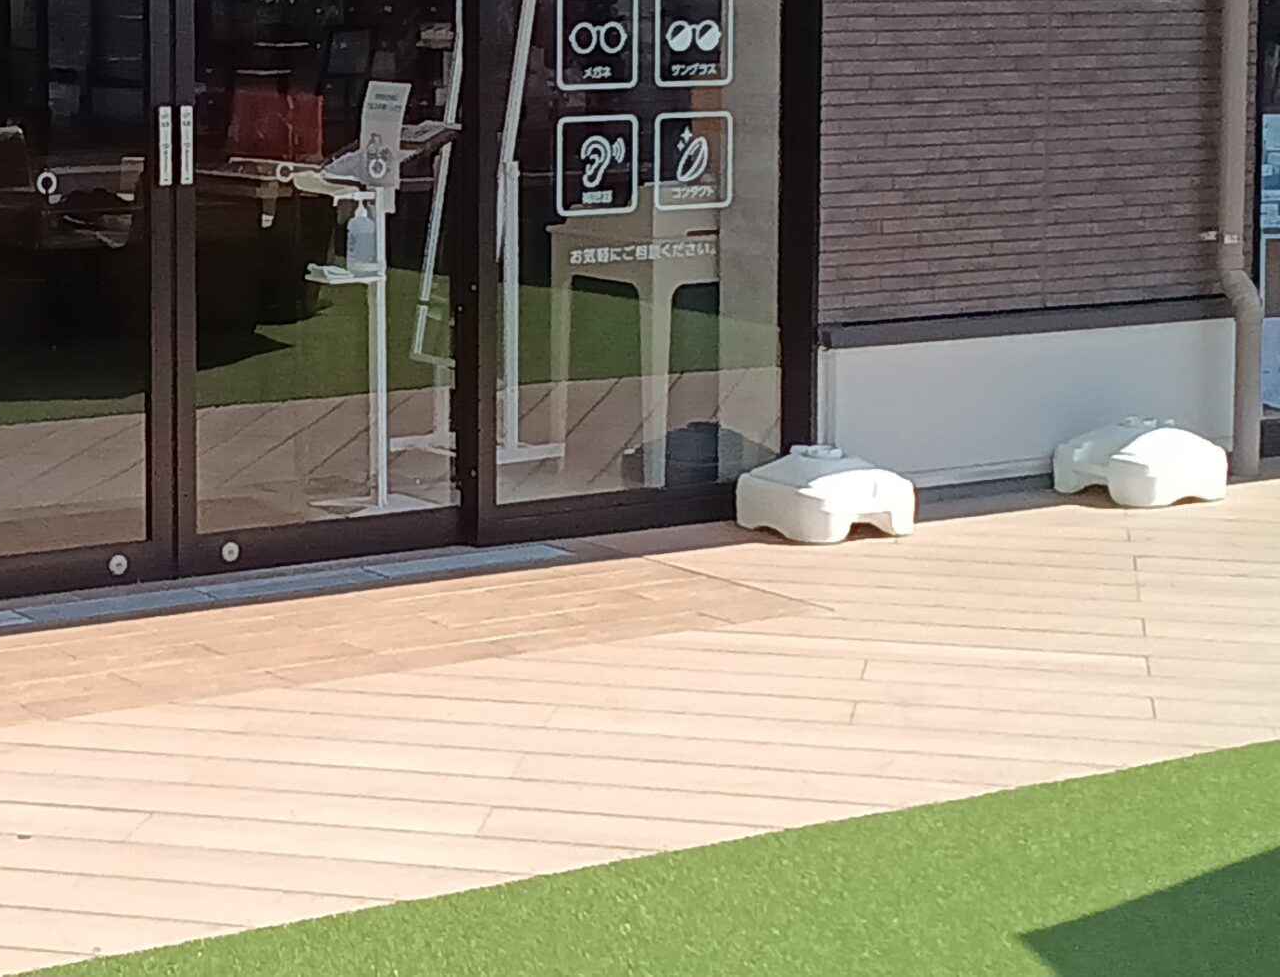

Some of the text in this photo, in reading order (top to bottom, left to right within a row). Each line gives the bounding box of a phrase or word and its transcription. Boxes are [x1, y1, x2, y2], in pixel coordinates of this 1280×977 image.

[582, 64, 612, 79] メガネ
[671, 63, 717, 77] サングラス
[671, 185, 715, 199] コンタクト
